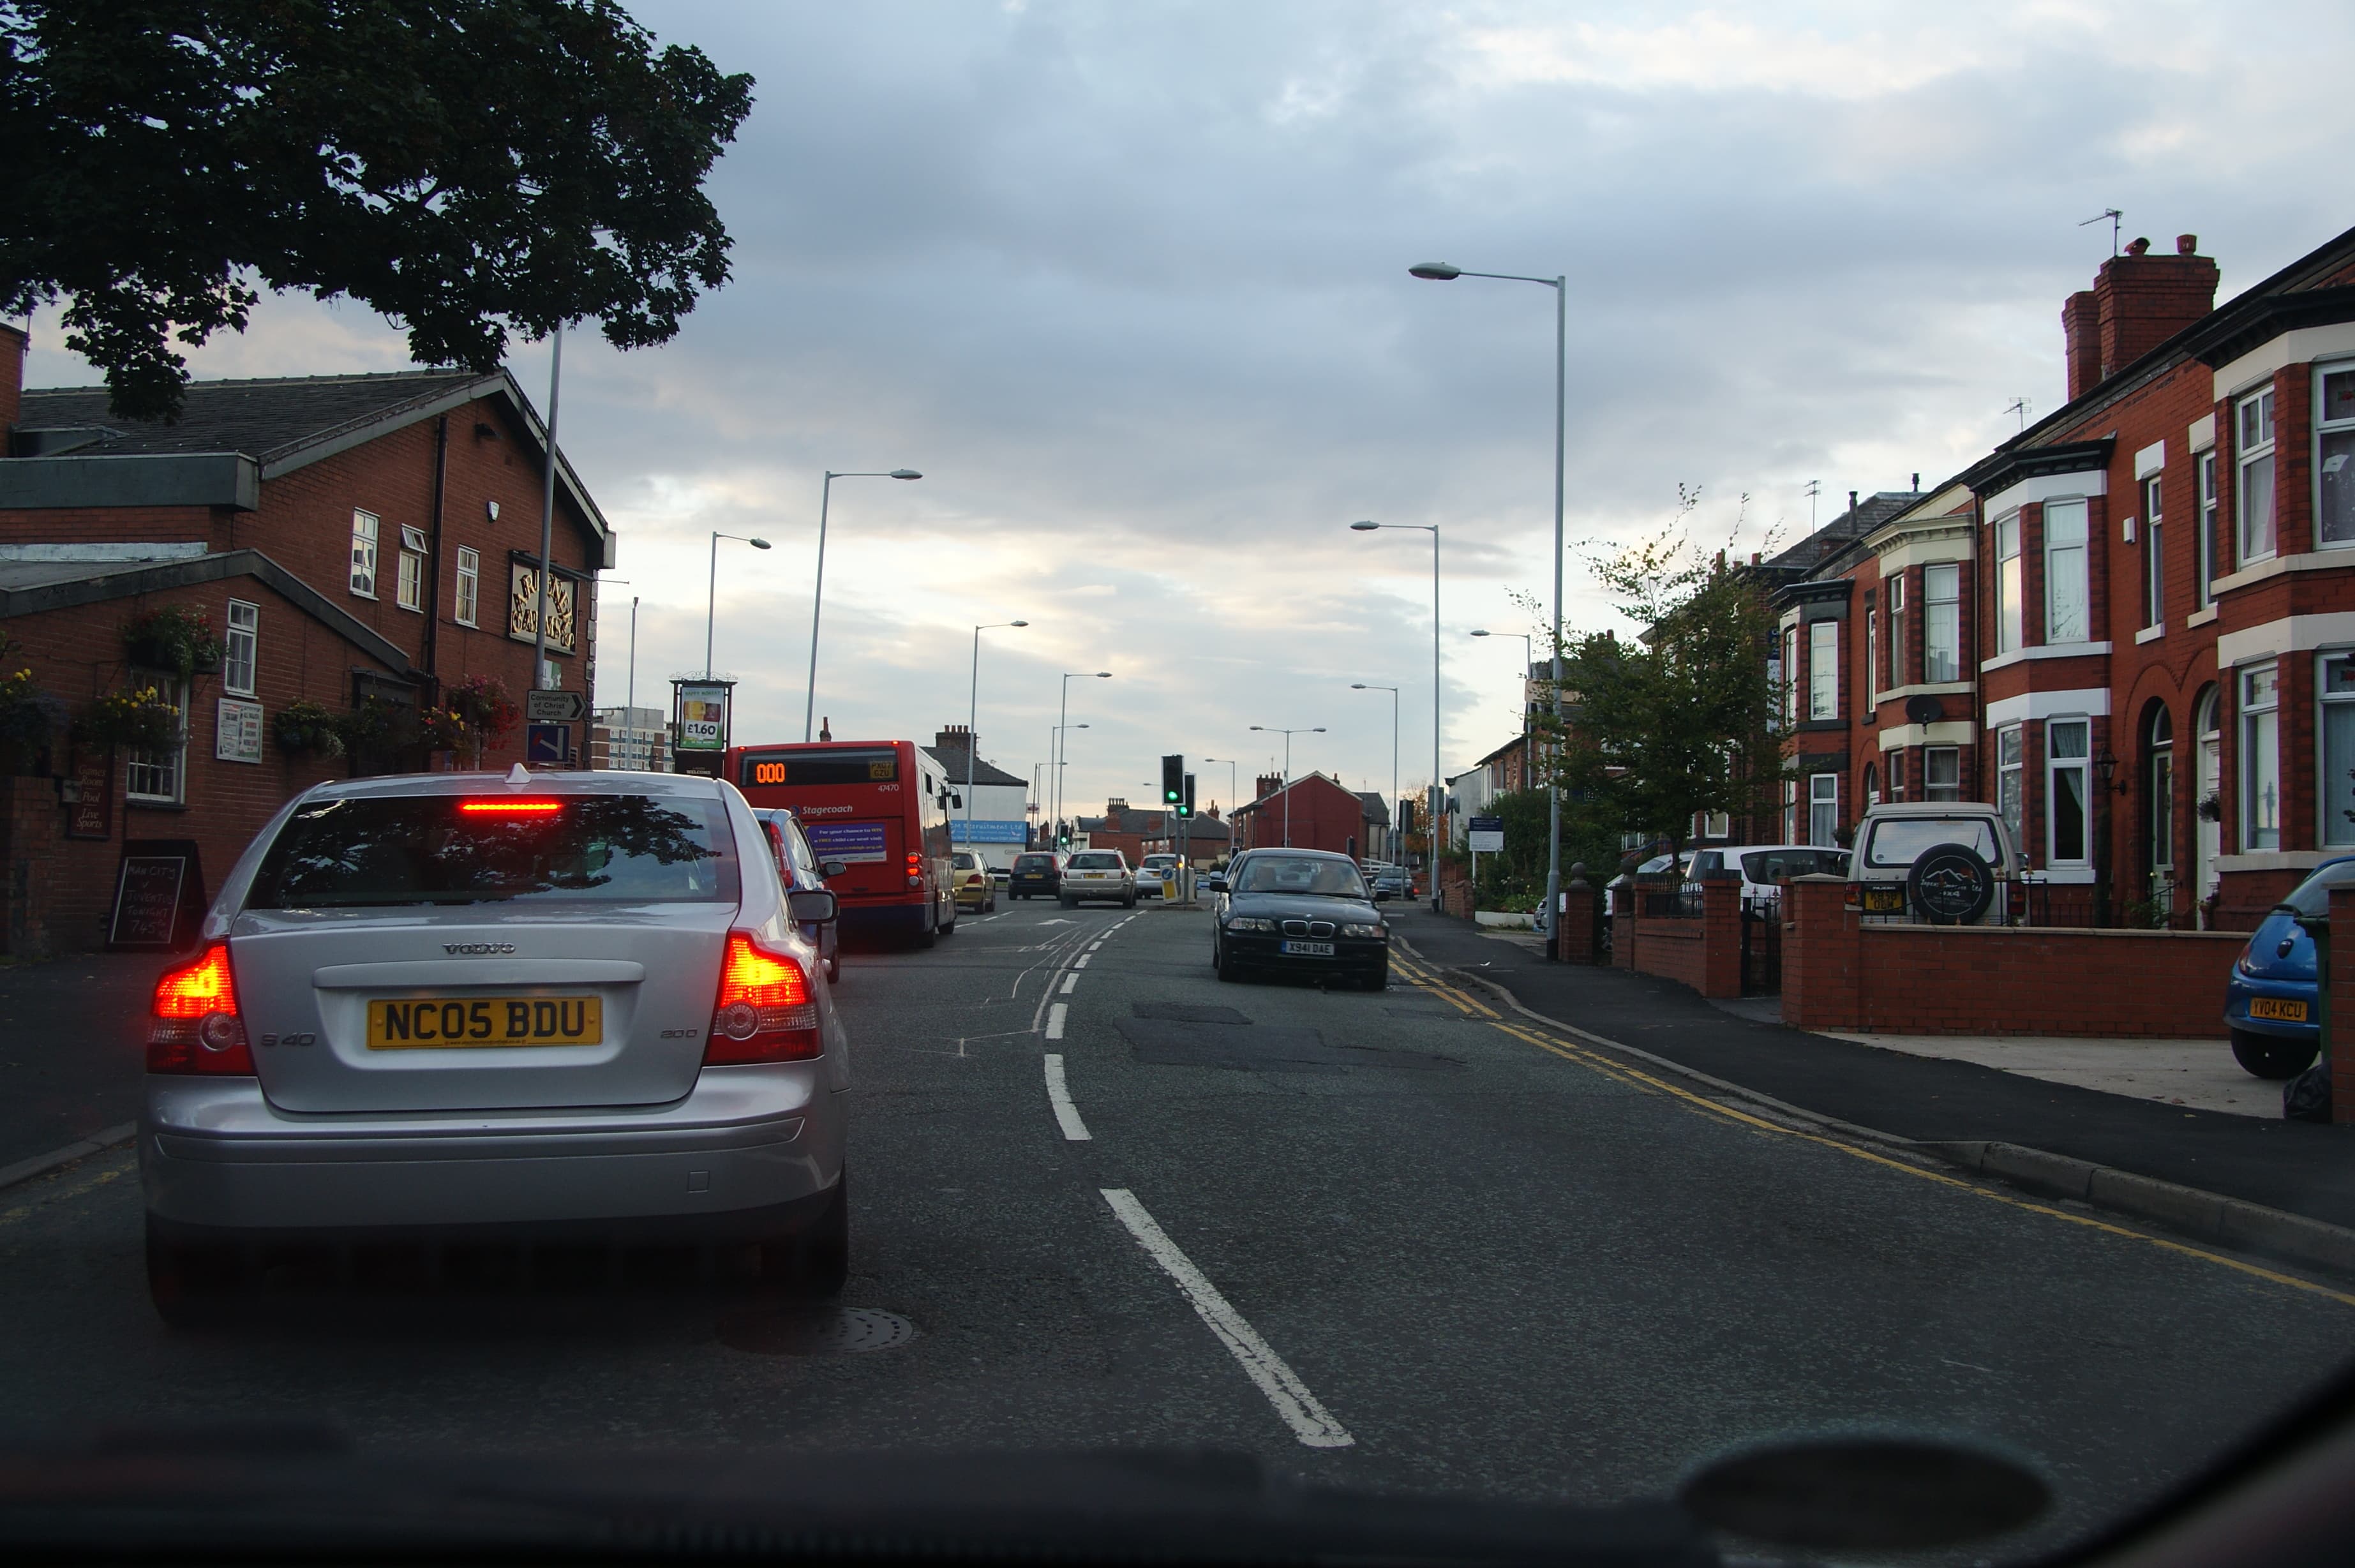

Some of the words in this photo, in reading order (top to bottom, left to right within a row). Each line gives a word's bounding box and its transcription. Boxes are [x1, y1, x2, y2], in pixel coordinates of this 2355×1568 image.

[687, 724, 716, 735] £1.60
[78, 765, 107, 776] Games
[82, 775, 105, 786] Room
[82, 791, 101, 802] Pool
[82, 808, 100, 819] Live
[802, 805, 853, 816] Stagecoach
[77, 817, 103, 830] Sports
[128, 865, 147, 875] MAN
[149, 865, 176, 879] CITY
[442, 943, 516, 955] VOLVO
[1290, 942, 1310, 952] X941
[1312, 944, 1331, 954] DAE
[2278, 1002, 2301, 1018] KCU
[385, 1003, 491, 1040] NC05
[506, 1001, 585, 1038] BDU
